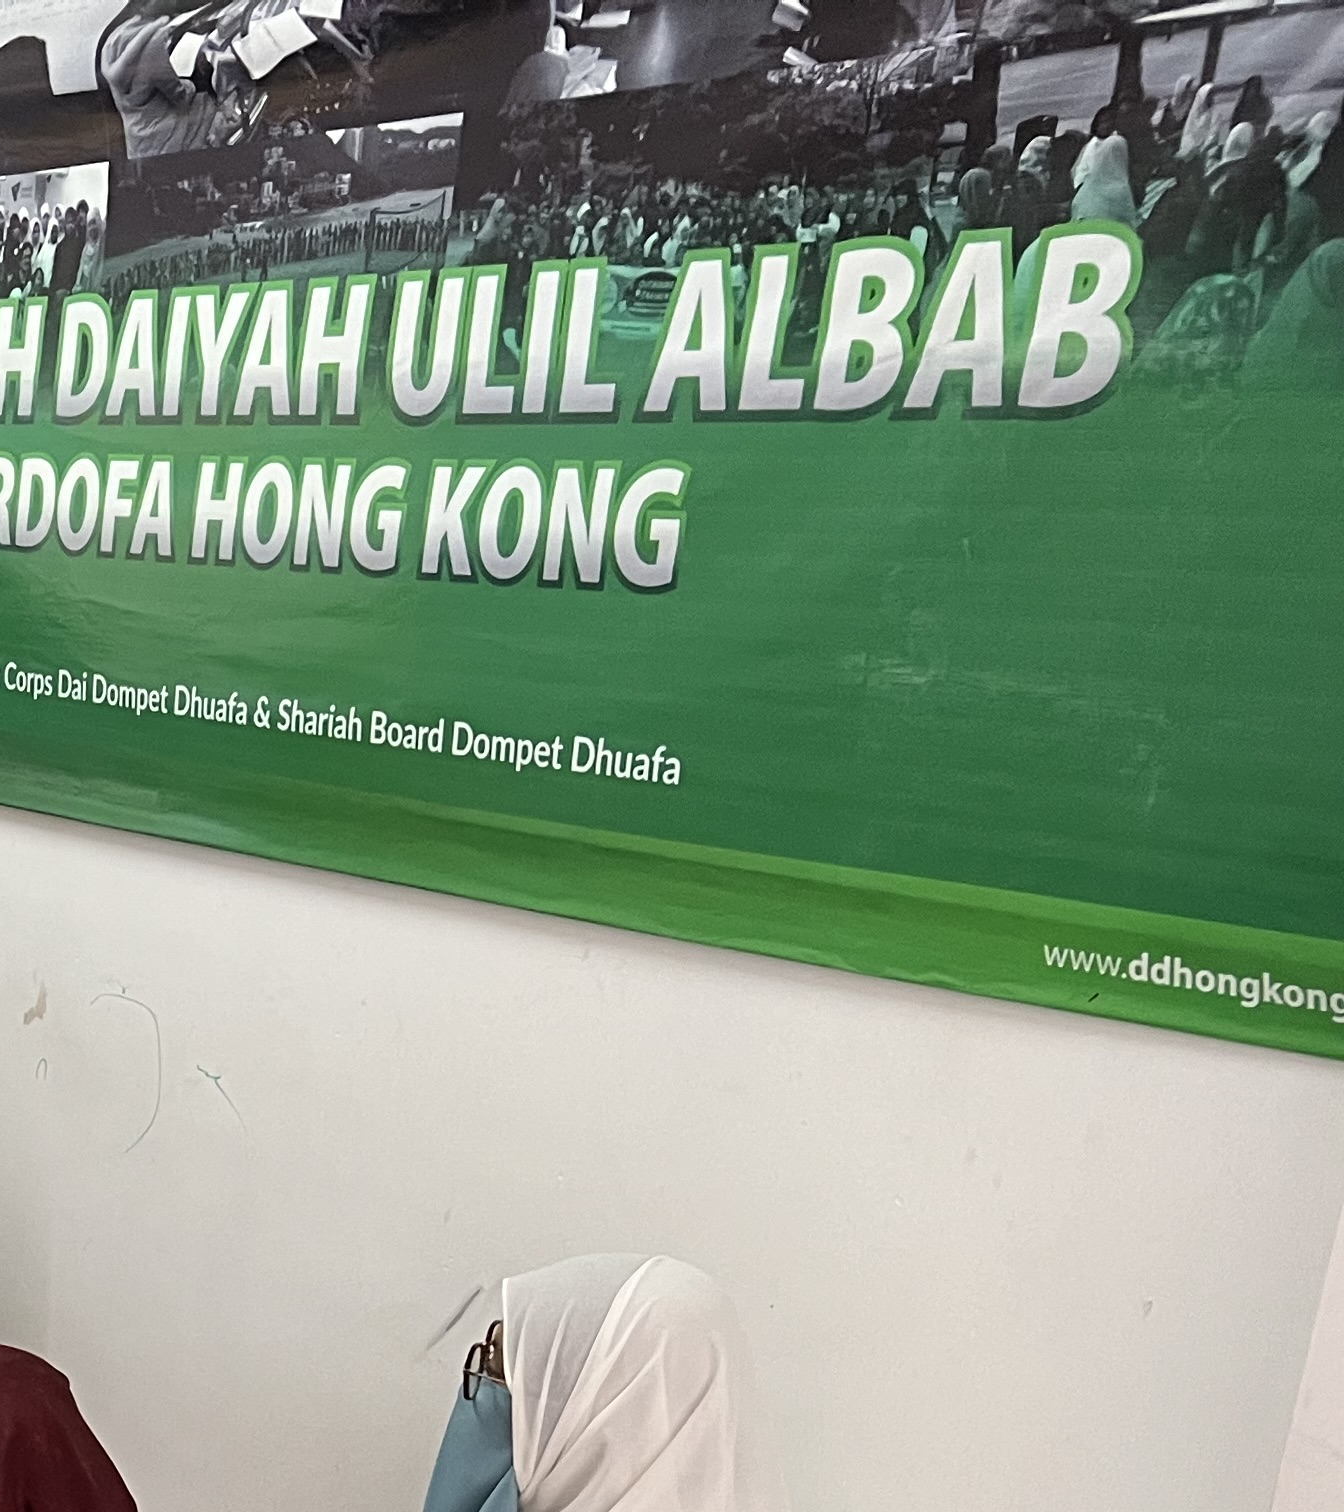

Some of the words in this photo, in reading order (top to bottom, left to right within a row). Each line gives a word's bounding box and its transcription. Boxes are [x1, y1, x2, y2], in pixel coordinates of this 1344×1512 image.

[55, 282, 371, 418] DAIYAH
[391, 267, 616, 417] ULIL
[643, 232, 1133, 412] ALBAB
[191, 461, 407, 572] HONG
[420, 466, 685, 588] KONG
[4, 661, 53, 700] Corps
[57, 668, 88, 702] Dai
[92, 673, 168, 716] Dompet
[173, 684, 248, 727] Dhuafa
[253, 695, 271, 729] &
[276, 698, 362, 742] Shariah
[369, 710, 445, 753] Board
[451, 720, 563, 771] Dompet
[571, 735, 682, 785] Dhuafa
